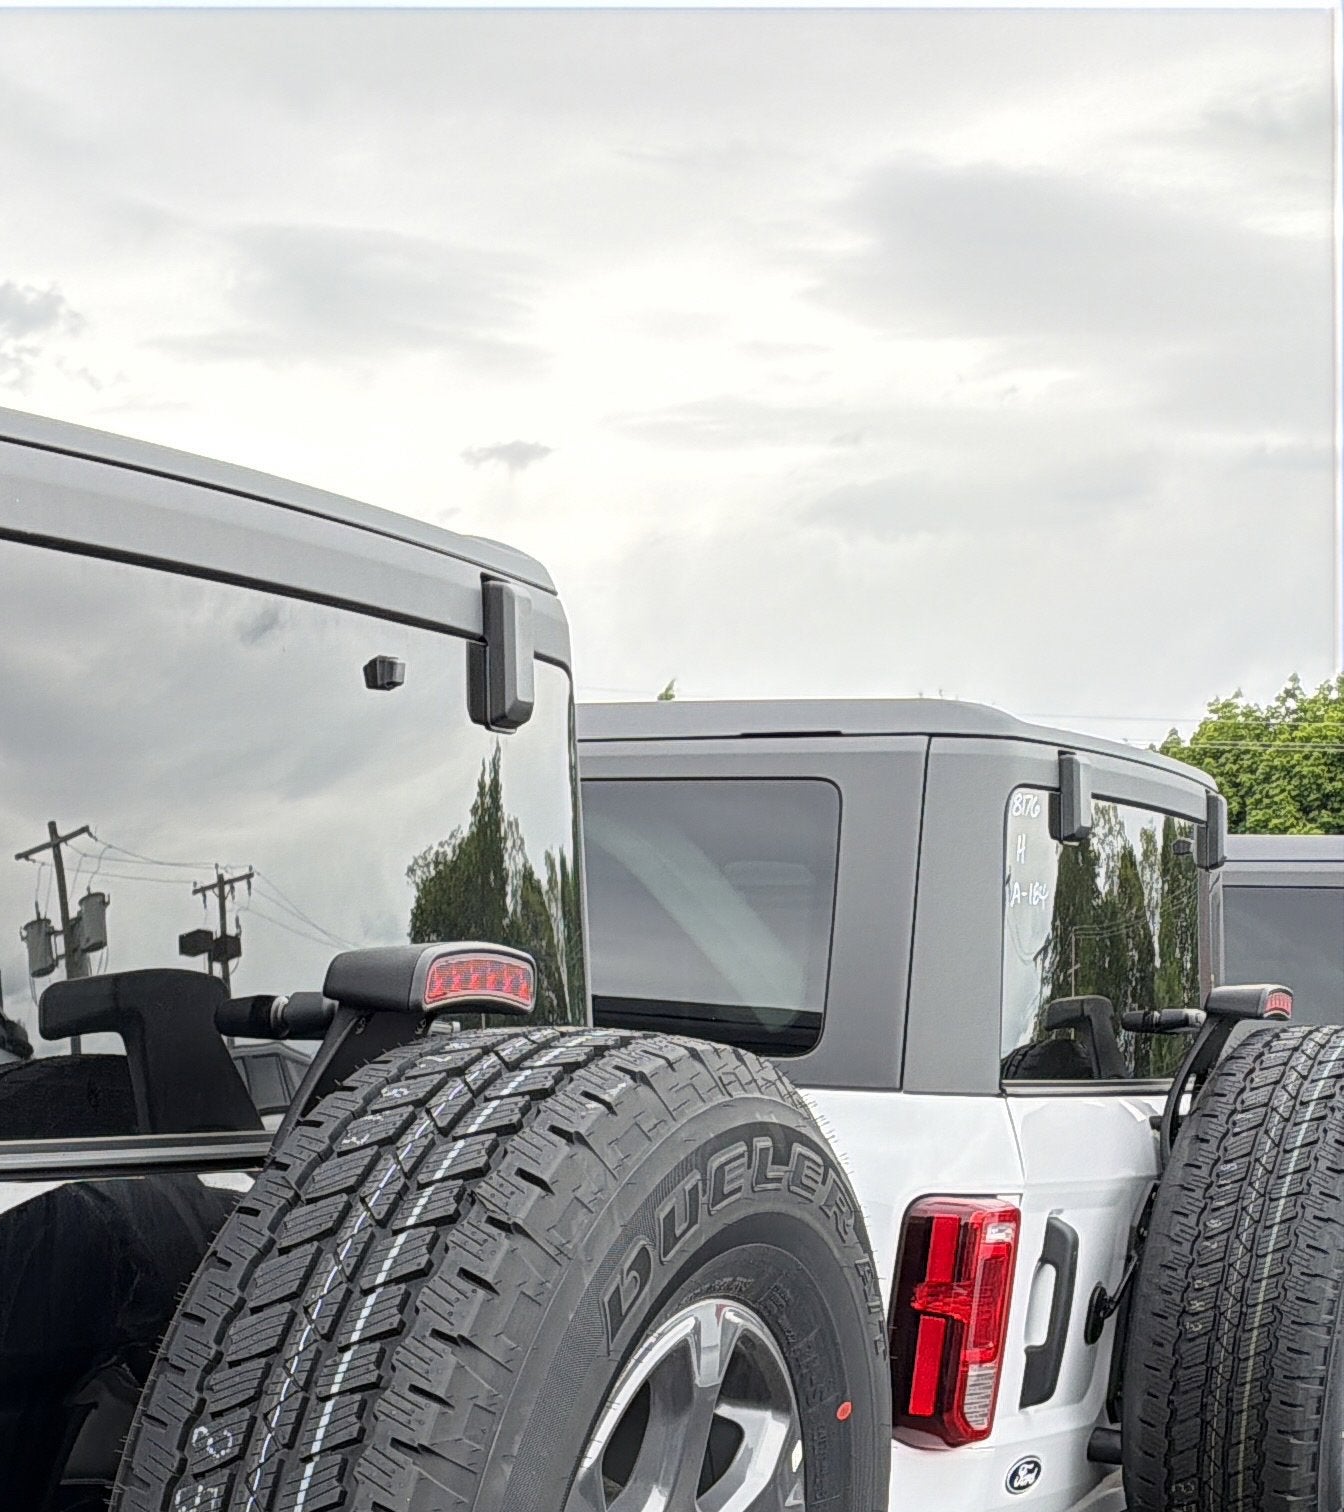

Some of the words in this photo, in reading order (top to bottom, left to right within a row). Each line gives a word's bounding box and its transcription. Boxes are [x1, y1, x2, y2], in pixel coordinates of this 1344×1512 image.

[1016, 833, 1026, 864] H
[602, 1136, 857, 1356] DUELER
[1013, 1463, 1039, 1488] Ford
